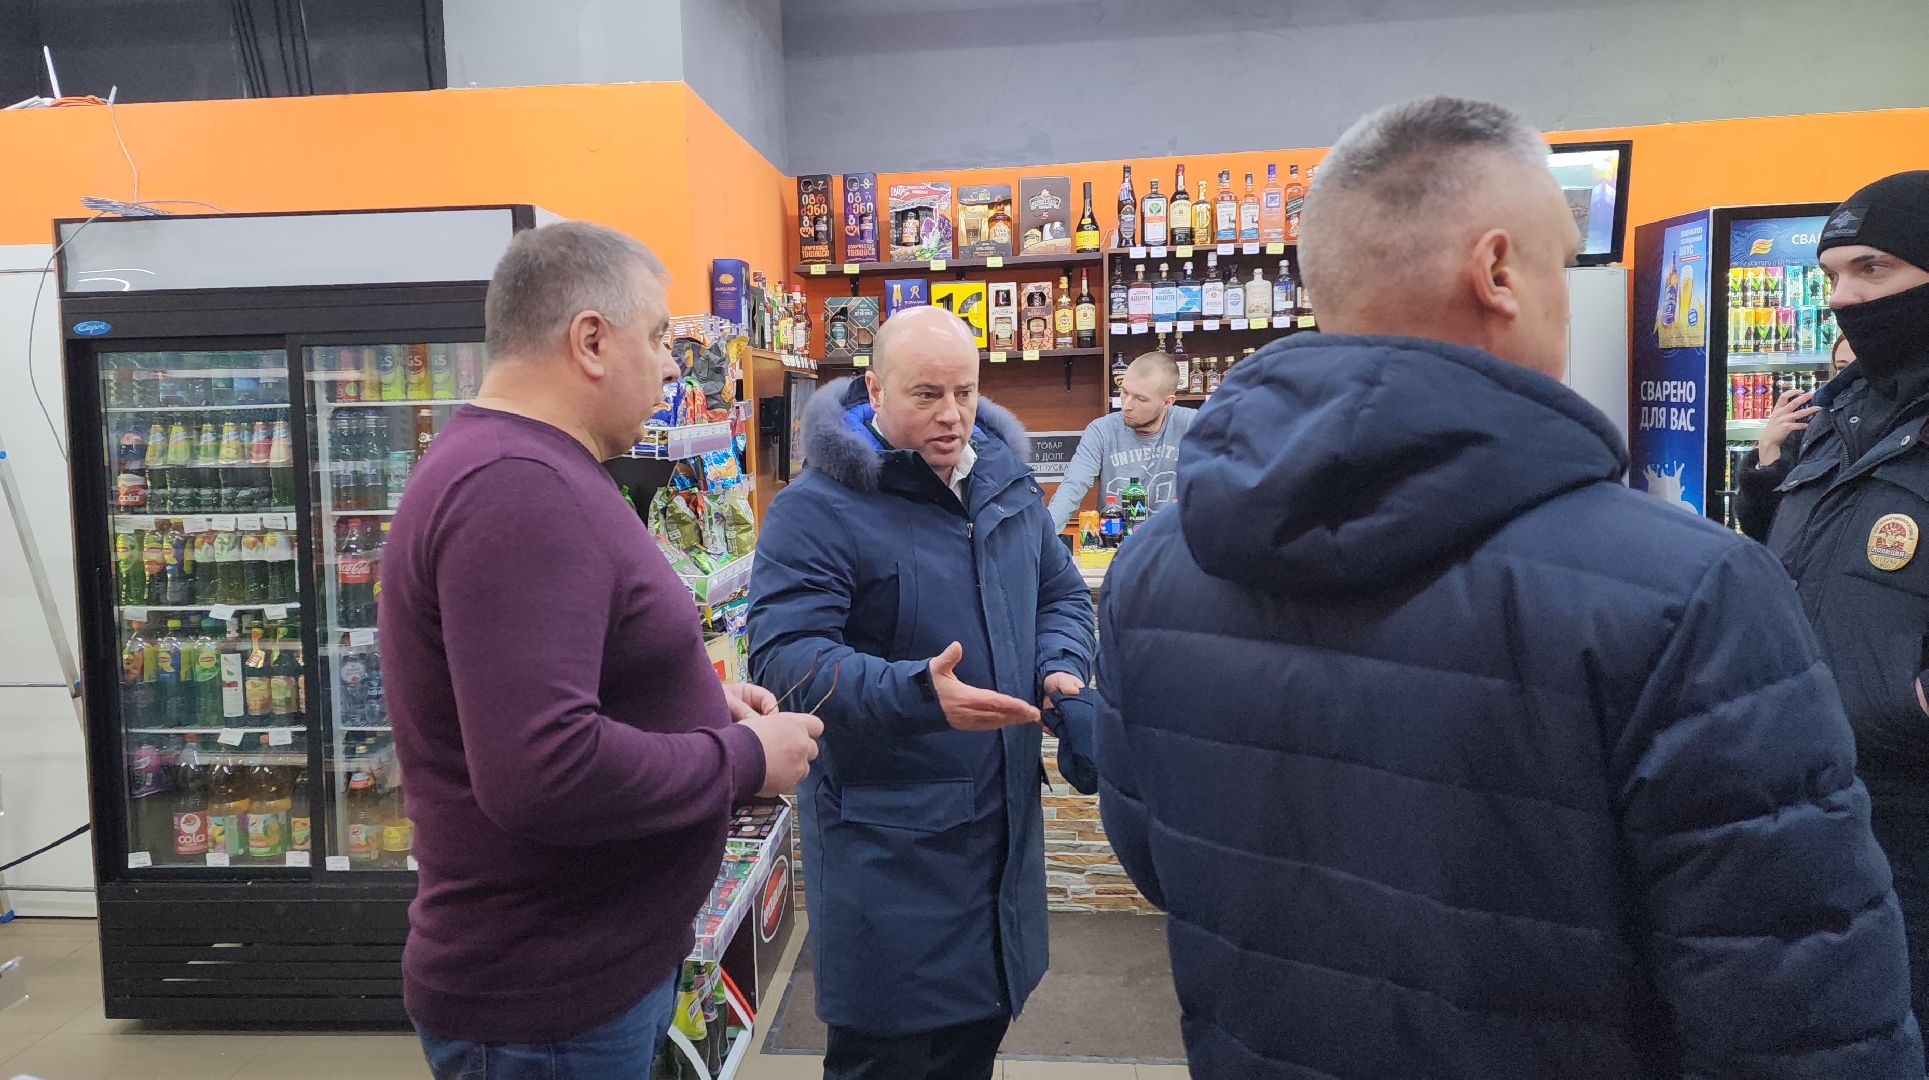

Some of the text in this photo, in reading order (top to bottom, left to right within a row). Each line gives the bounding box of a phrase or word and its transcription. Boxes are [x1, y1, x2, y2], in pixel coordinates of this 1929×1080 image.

[1641, 381, 1696, 403] СВАРЕНО
[1640, 407, 1695, 431] ДЛЯ ВАС
[1037, 442, 1063, 450] ТОВАР
[1042, 453, 1064, 461] ДОЛГ
[178, 833, 205, 844] cola
